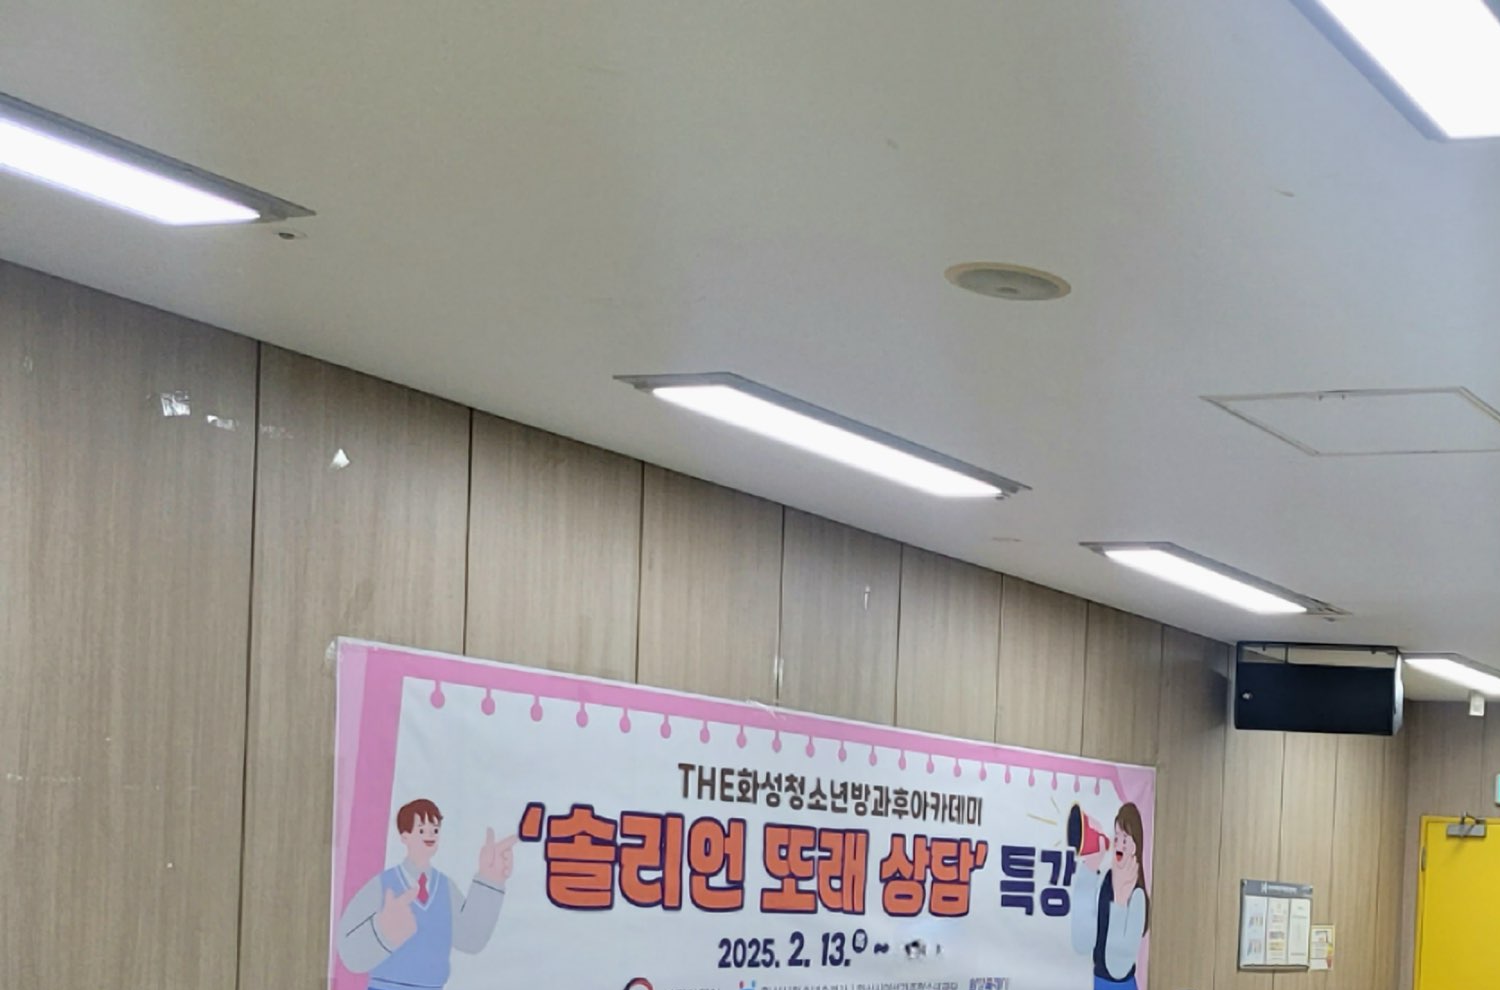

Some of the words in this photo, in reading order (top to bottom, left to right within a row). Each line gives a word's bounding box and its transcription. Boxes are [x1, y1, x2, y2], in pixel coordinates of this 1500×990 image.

[678, 762, 983, 827] THE화성청소년방과후아카데미
[759, 821, 870, 915] 또래
[999, 844, 1077, 917] 특강
[717, 937, 780, 969] 2025.
[787, 931, 811, 968] 2.
